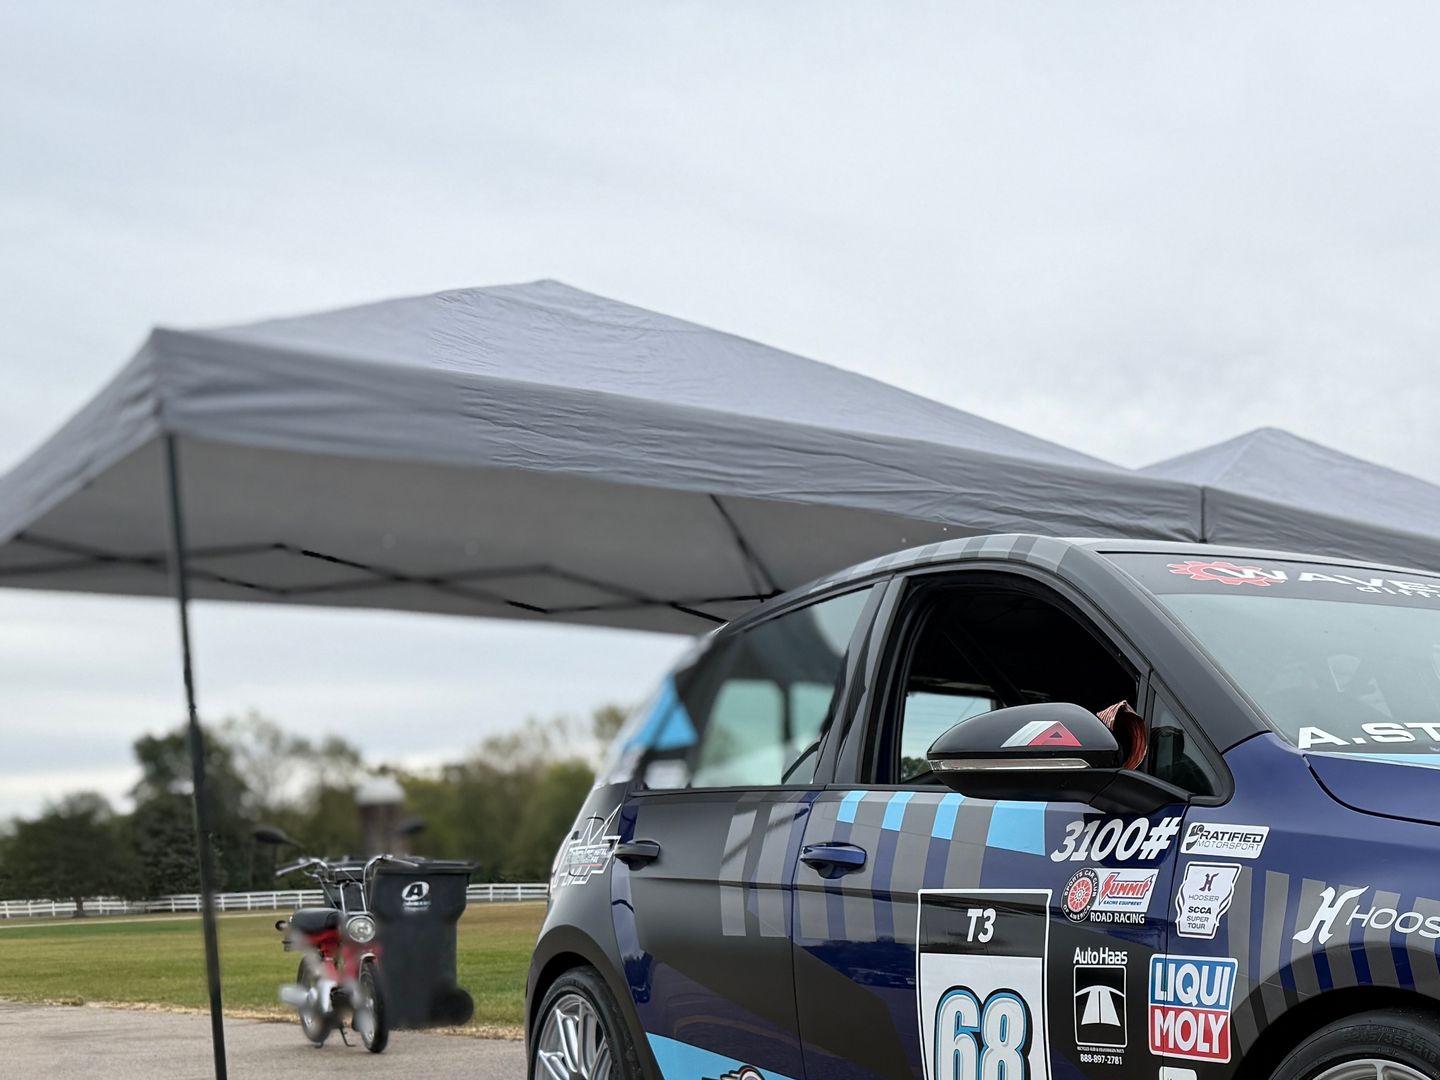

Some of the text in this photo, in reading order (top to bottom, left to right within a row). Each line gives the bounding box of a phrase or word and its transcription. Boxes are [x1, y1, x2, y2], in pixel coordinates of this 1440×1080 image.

[1050, 817, 1182, 862] 3100#
[1196, 840, 1260, 851] MOTORSPORT
[1099, 872, 1156, 905] SUMMIT
[1189, 894, 1220, 902] HOOSIER
[1188, 906, 1212, 915] SCCA
[1090, 911, 1145, 924] ROAD RACING
[1186, 915, 1210, 923] SUPER
[967, 908, 996, 943] T3
[1187, 922, 1206, 930] TOUR
[1073, 947, 1128, 965] Auto Haas
[1154, 962, 1231, 1007] LIQUI
[1154, 1008, 1228, 1054] MOLY
[1080, 1053, 1123, 1065] 888-897-2781
